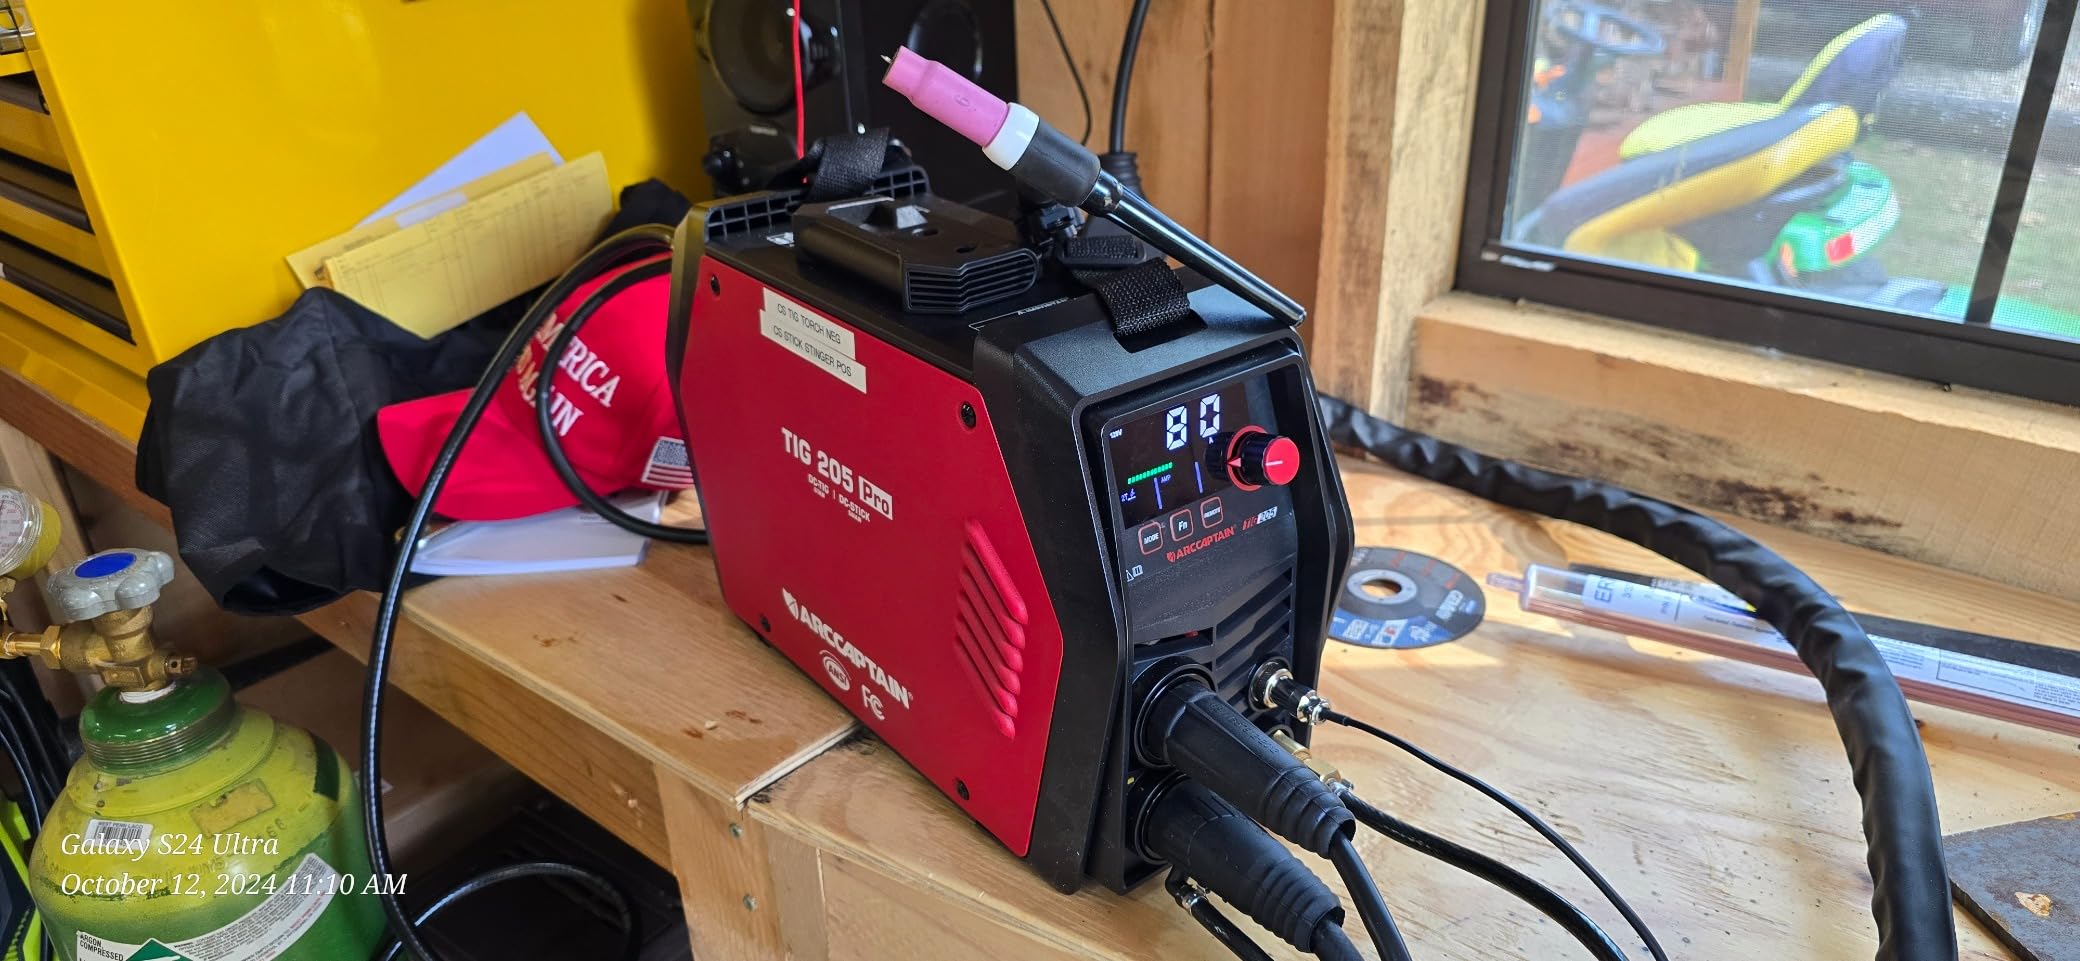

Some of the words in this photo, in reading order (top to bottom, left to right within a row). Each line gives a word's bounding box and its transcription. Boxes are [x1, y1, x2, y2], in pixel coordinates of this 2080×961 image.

[777, 303, 787, 316] CS
[788, 308, 799, 323] TIG
[800, 314, 825, 334] TORCH
[826, 328, 841, 344] NEG
[536, 312, 621, 408] MRICA
[773, 326, 783, 338] CS
[784, 331, 803, 350] STICK
[805, 342, 835, 367] STINGER
[836, 361, 852, 377] POS
[1166, 393, 1221, 451] 80
[781, 426, 812, 466] TIG
[817, 450, 854, 493] 205
[861, 478, 891, 517] Pro
[839, 494, 871, 522] DC-STICK
[1178, 520, 1188, 532] Fn
[1143, 532, 1159, 544] MODE
[1176, 527, 1236, 559] ARCCAPTAIN
[1594, 576, 1616, 603] ER
[800, 604, 910, 710] ARCCAPTAIN
[79, 940, 124, 961] COMPRESSED
